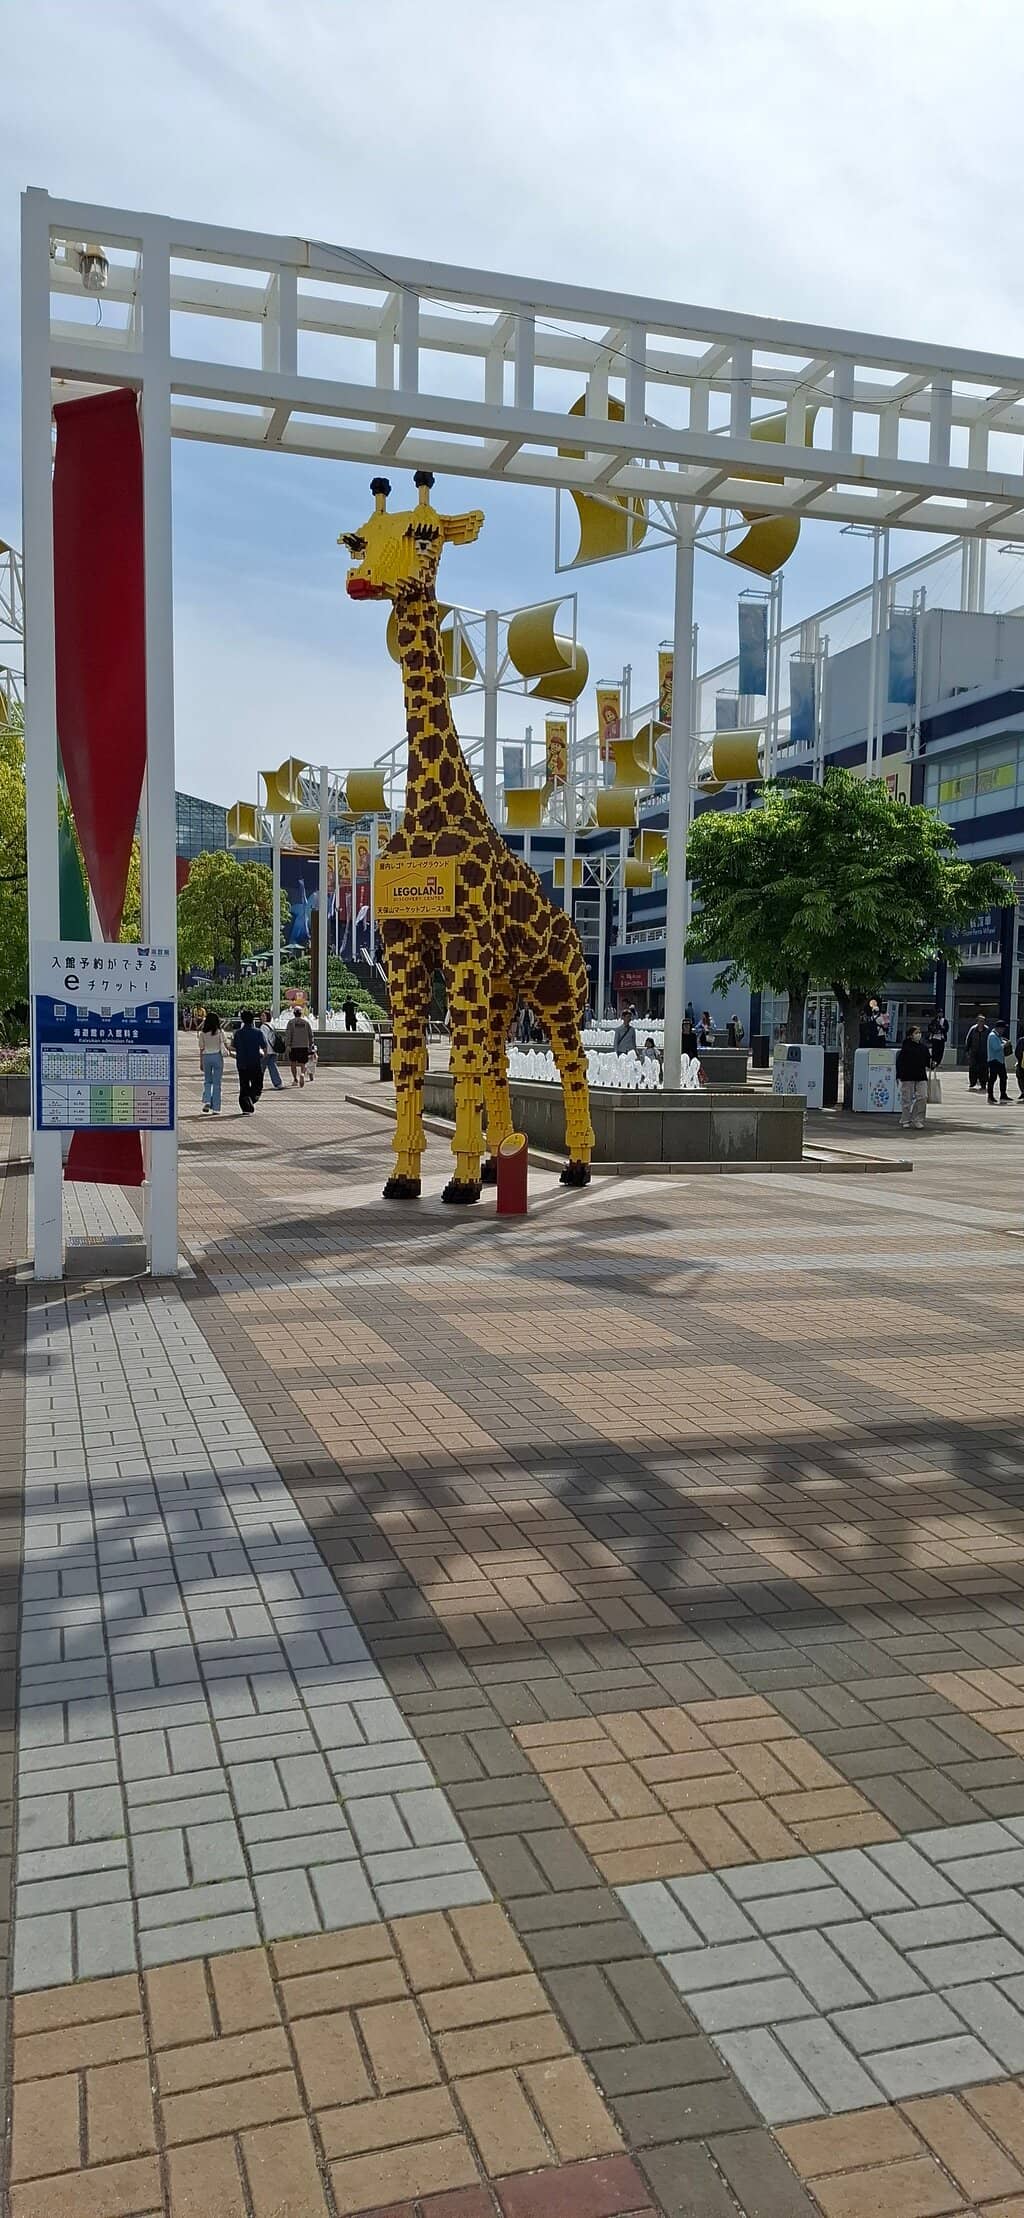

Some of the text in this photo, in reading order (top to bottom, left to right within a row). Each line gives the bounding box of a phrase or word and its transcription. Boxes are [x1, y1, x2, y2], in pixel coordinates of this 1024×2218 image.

[393, 884, 444, 897] LEGOLAND
[51, 956, 157, 971] 入館予約ができる
